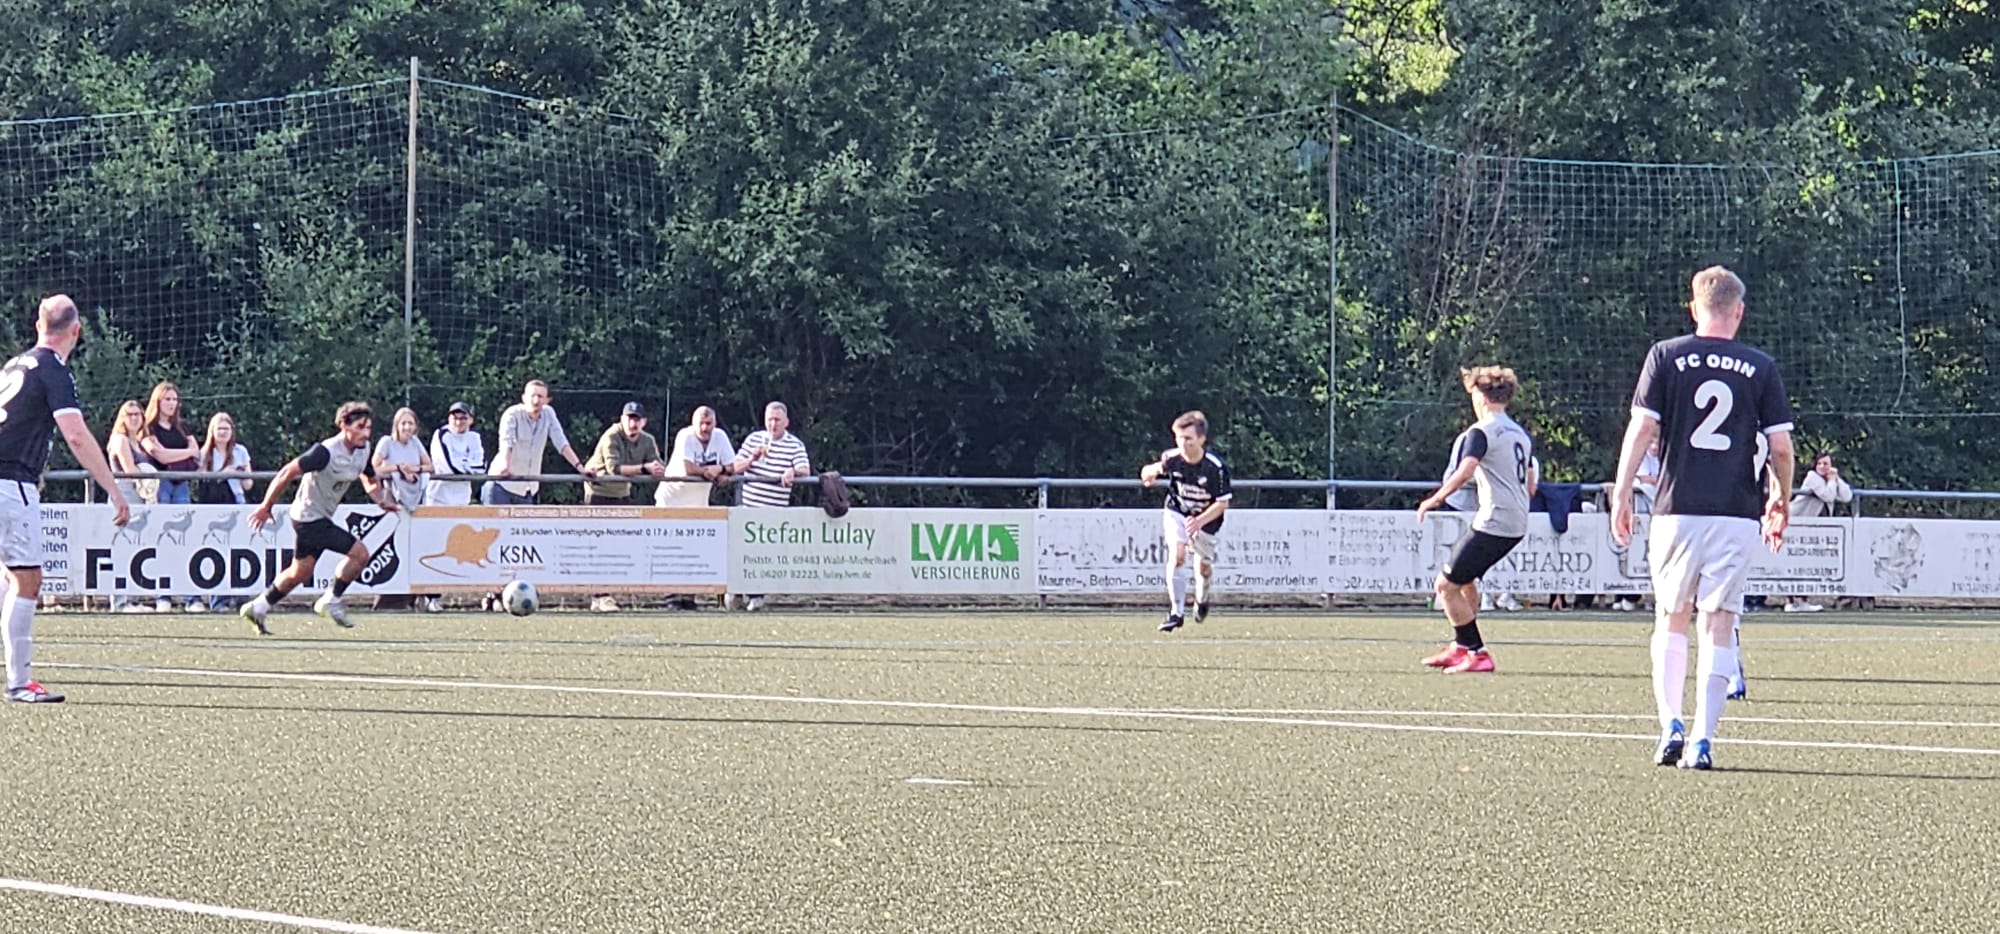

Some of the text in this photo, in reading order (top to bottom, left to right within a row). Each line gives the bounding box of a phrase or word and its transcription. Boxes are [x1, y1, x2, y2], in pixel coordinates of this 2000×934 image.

[1675, 354, 1756, 378] FC ODIN
[1690, 379, 1733, 451] 2
[1514, 442, 1525, 484] 8
[522, 527, 553, 536] Stunden
[744, 521, 875, 550] Stefan Lulay
[911, 523, 983, 561] LVM
[86, 548, 171, 589] F.C.
[360, 544, 395, 583] ODIN
[500, 545, 543, 564] KSM
[823, 555, 897, 565] Wald-Michelbach
[911, 565, 1020, 580] VERSICHERUNG
